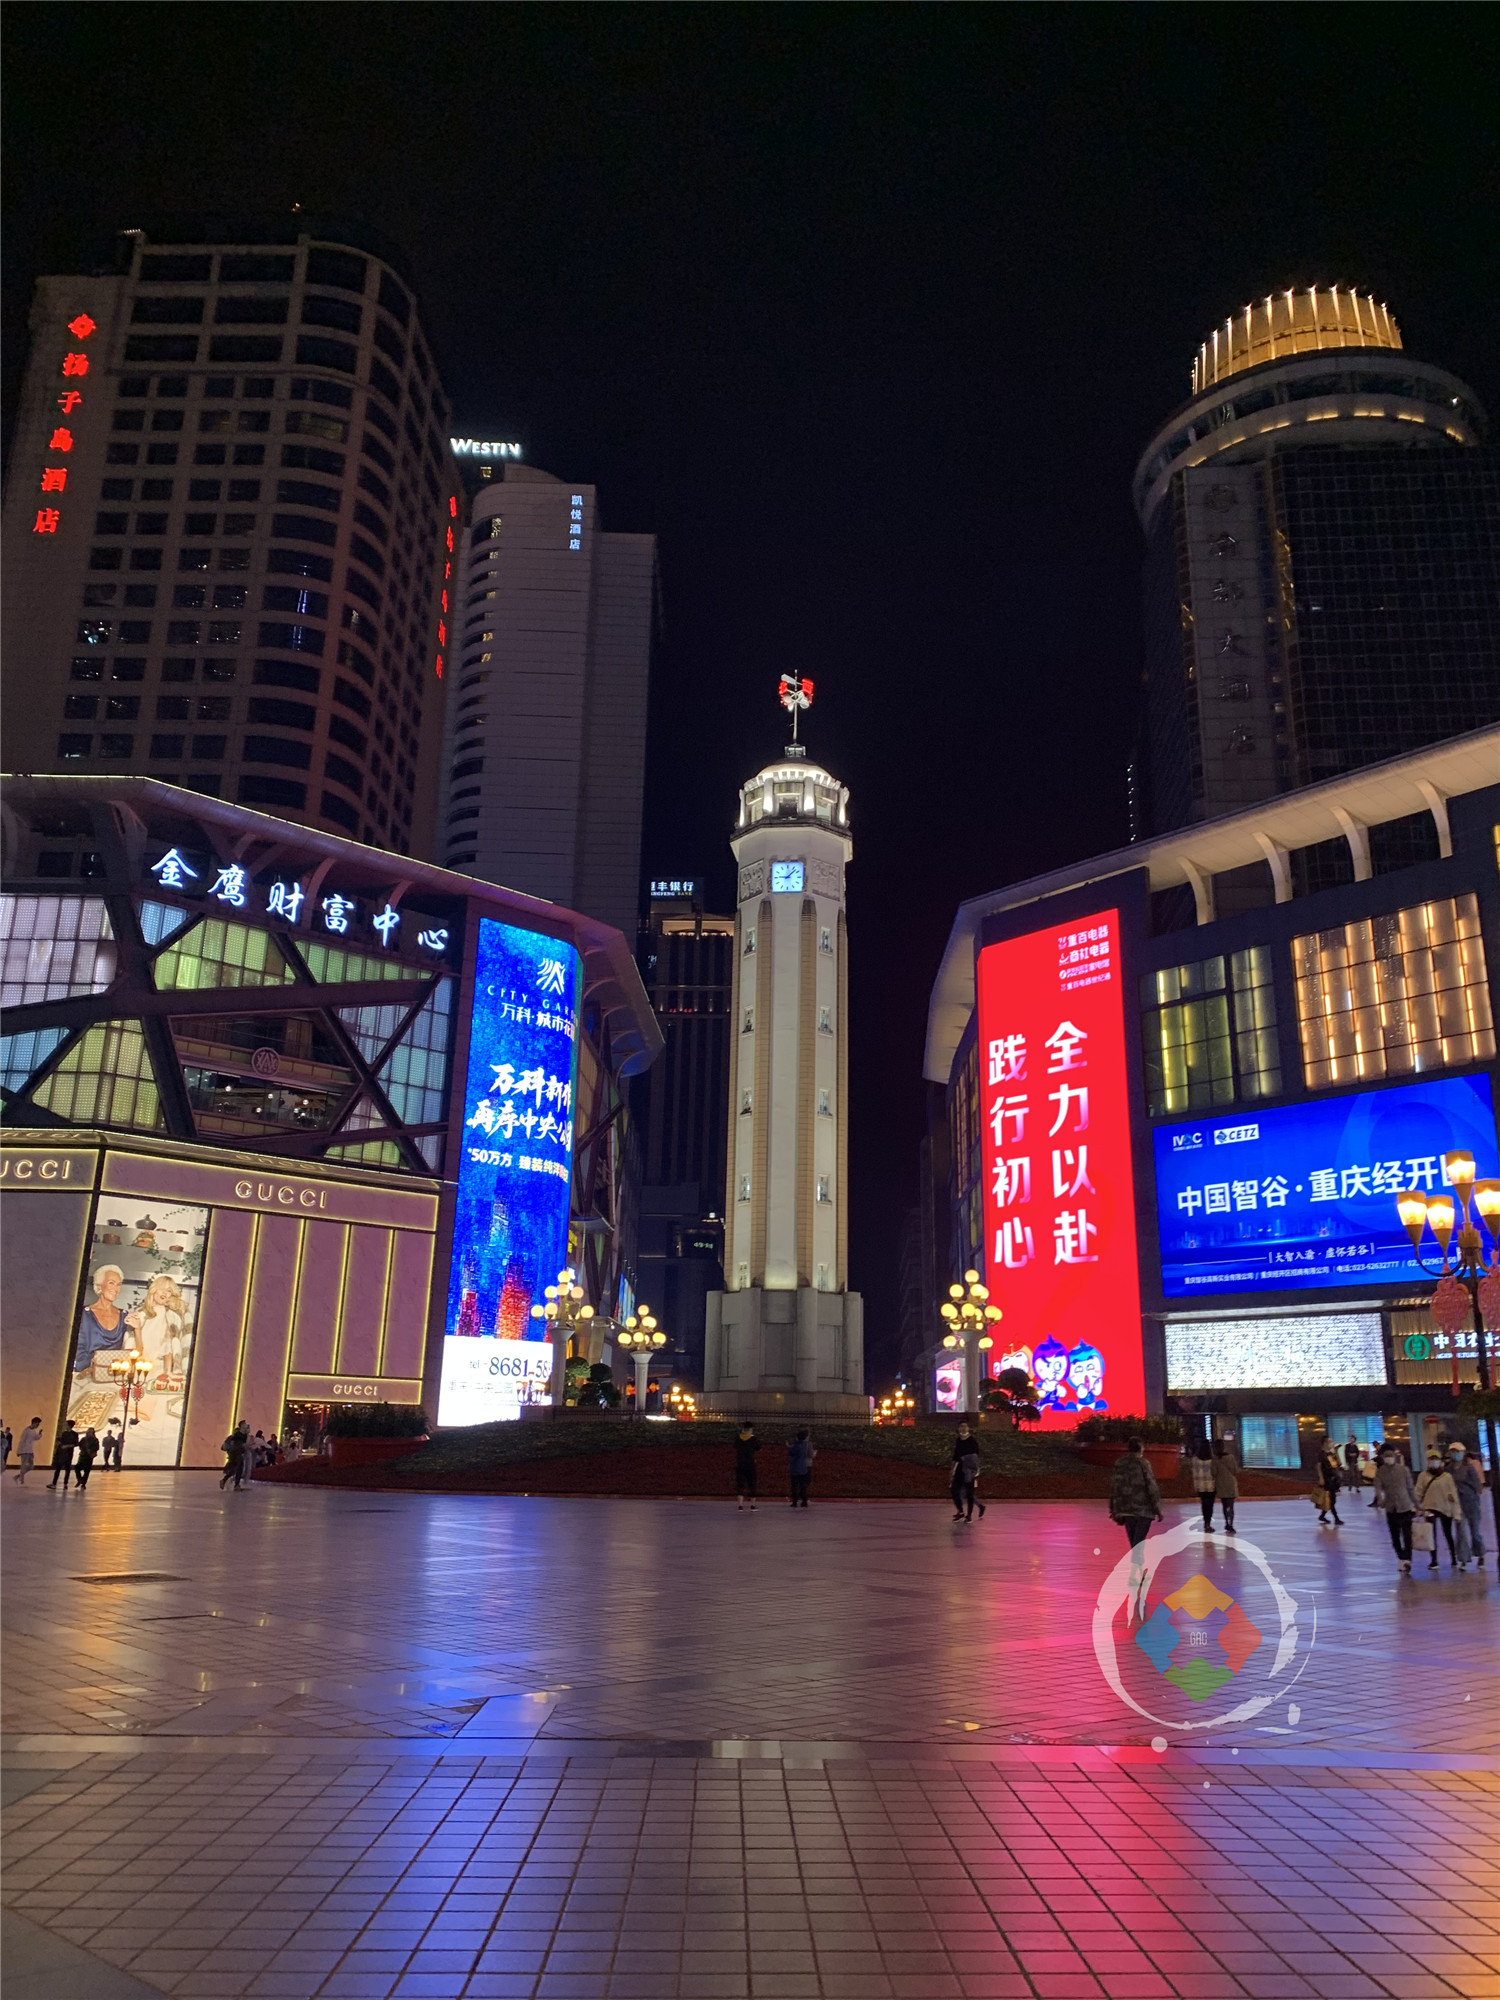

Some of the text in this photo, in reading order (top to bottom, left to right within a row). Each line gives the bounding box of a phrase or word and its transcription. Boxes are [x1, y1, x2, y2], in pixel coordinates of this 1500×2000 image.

[33, 352, 89, 534] 扬子岛酒店
[450, 438, 522, 460] WESTIN
[569, 494, 583, 550] 凯悦酒店
[150, 848, 449, 951] 金鹰财富中心
[487, 985, 528, 1004] CITY
[988, 1033, 1036, 1269] 践行初心
[1044, 1020, 1099, 1266] 全力以赴
[1228, 1127, 1257, 1141] CETZ
[235, 1180, 327, 1209] GUCCI
[333, 1383, 379, 1397] GUCCI
